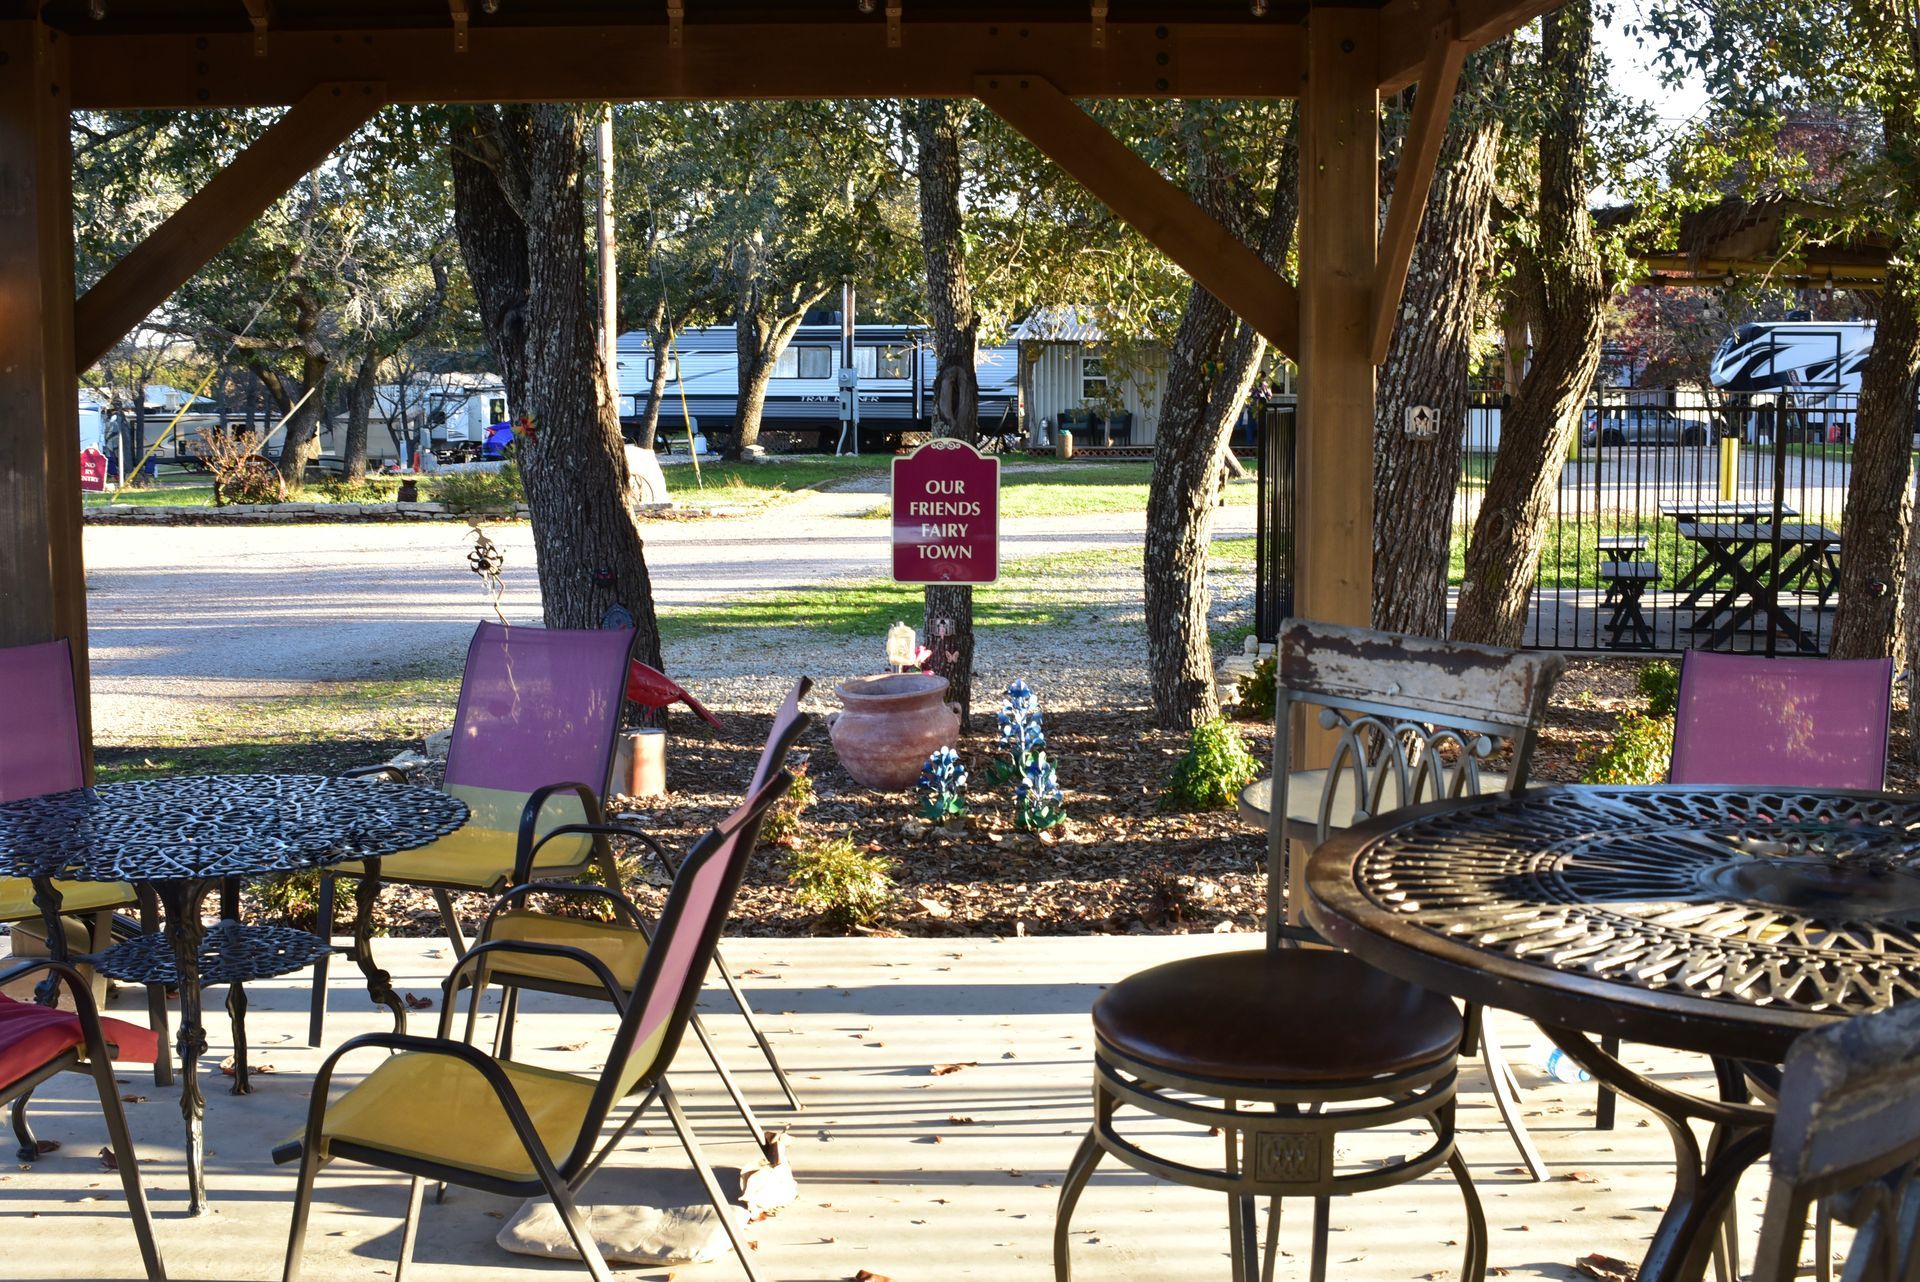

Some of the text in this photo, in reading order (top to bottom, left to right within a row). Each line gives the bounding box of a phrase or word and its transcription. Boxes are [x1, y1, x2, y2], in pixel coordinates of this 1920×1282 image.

[925, 480, 965, 494] OUR
[910, 502, 981, 516] FRIENDS
[921, 523, 968, 537] FAIRY
[917, 545, 972, 559] TOWN
